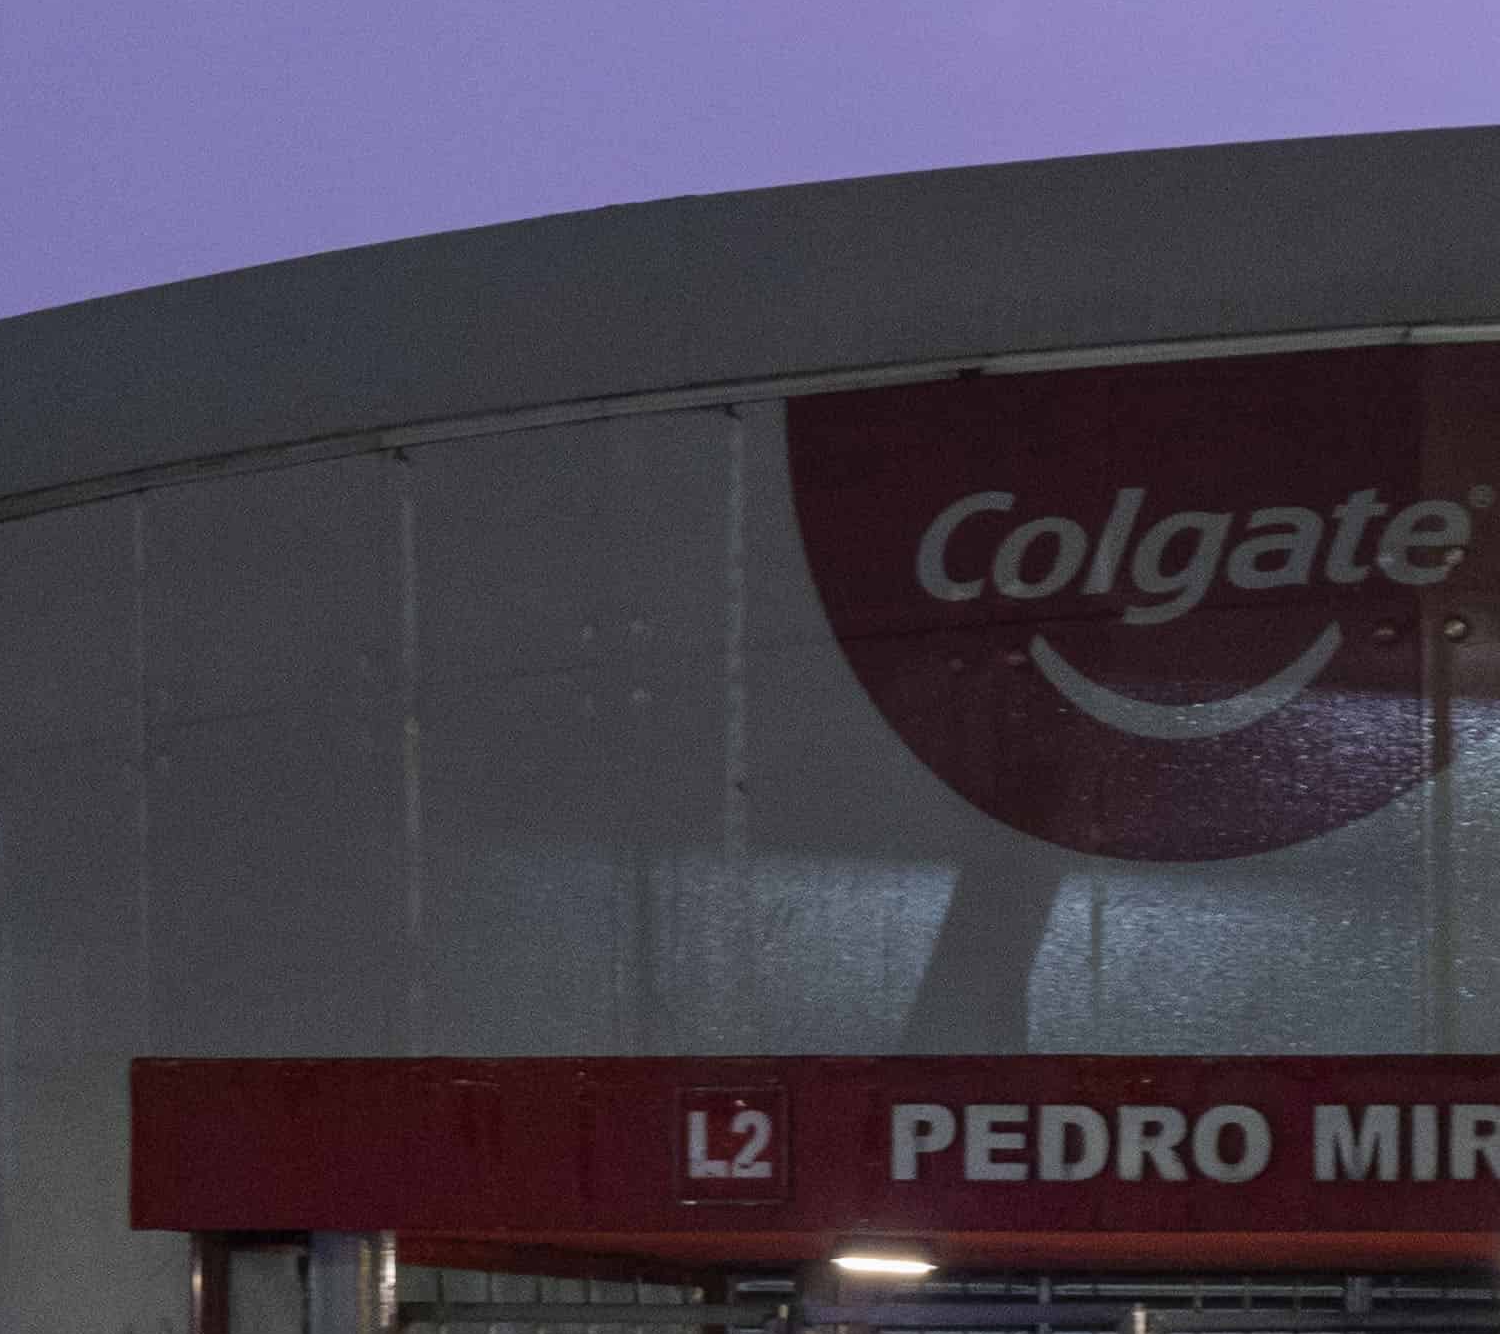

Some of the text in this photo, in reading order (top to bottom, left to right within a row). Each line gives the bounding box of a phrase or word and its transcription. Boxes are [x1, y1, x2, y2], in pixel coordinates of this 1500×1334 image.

[914, 485, 1472, 627] Colgate
[687, 1110, 773, 1179] L2
[890, 1103, 1273, 1183] PEDRO
